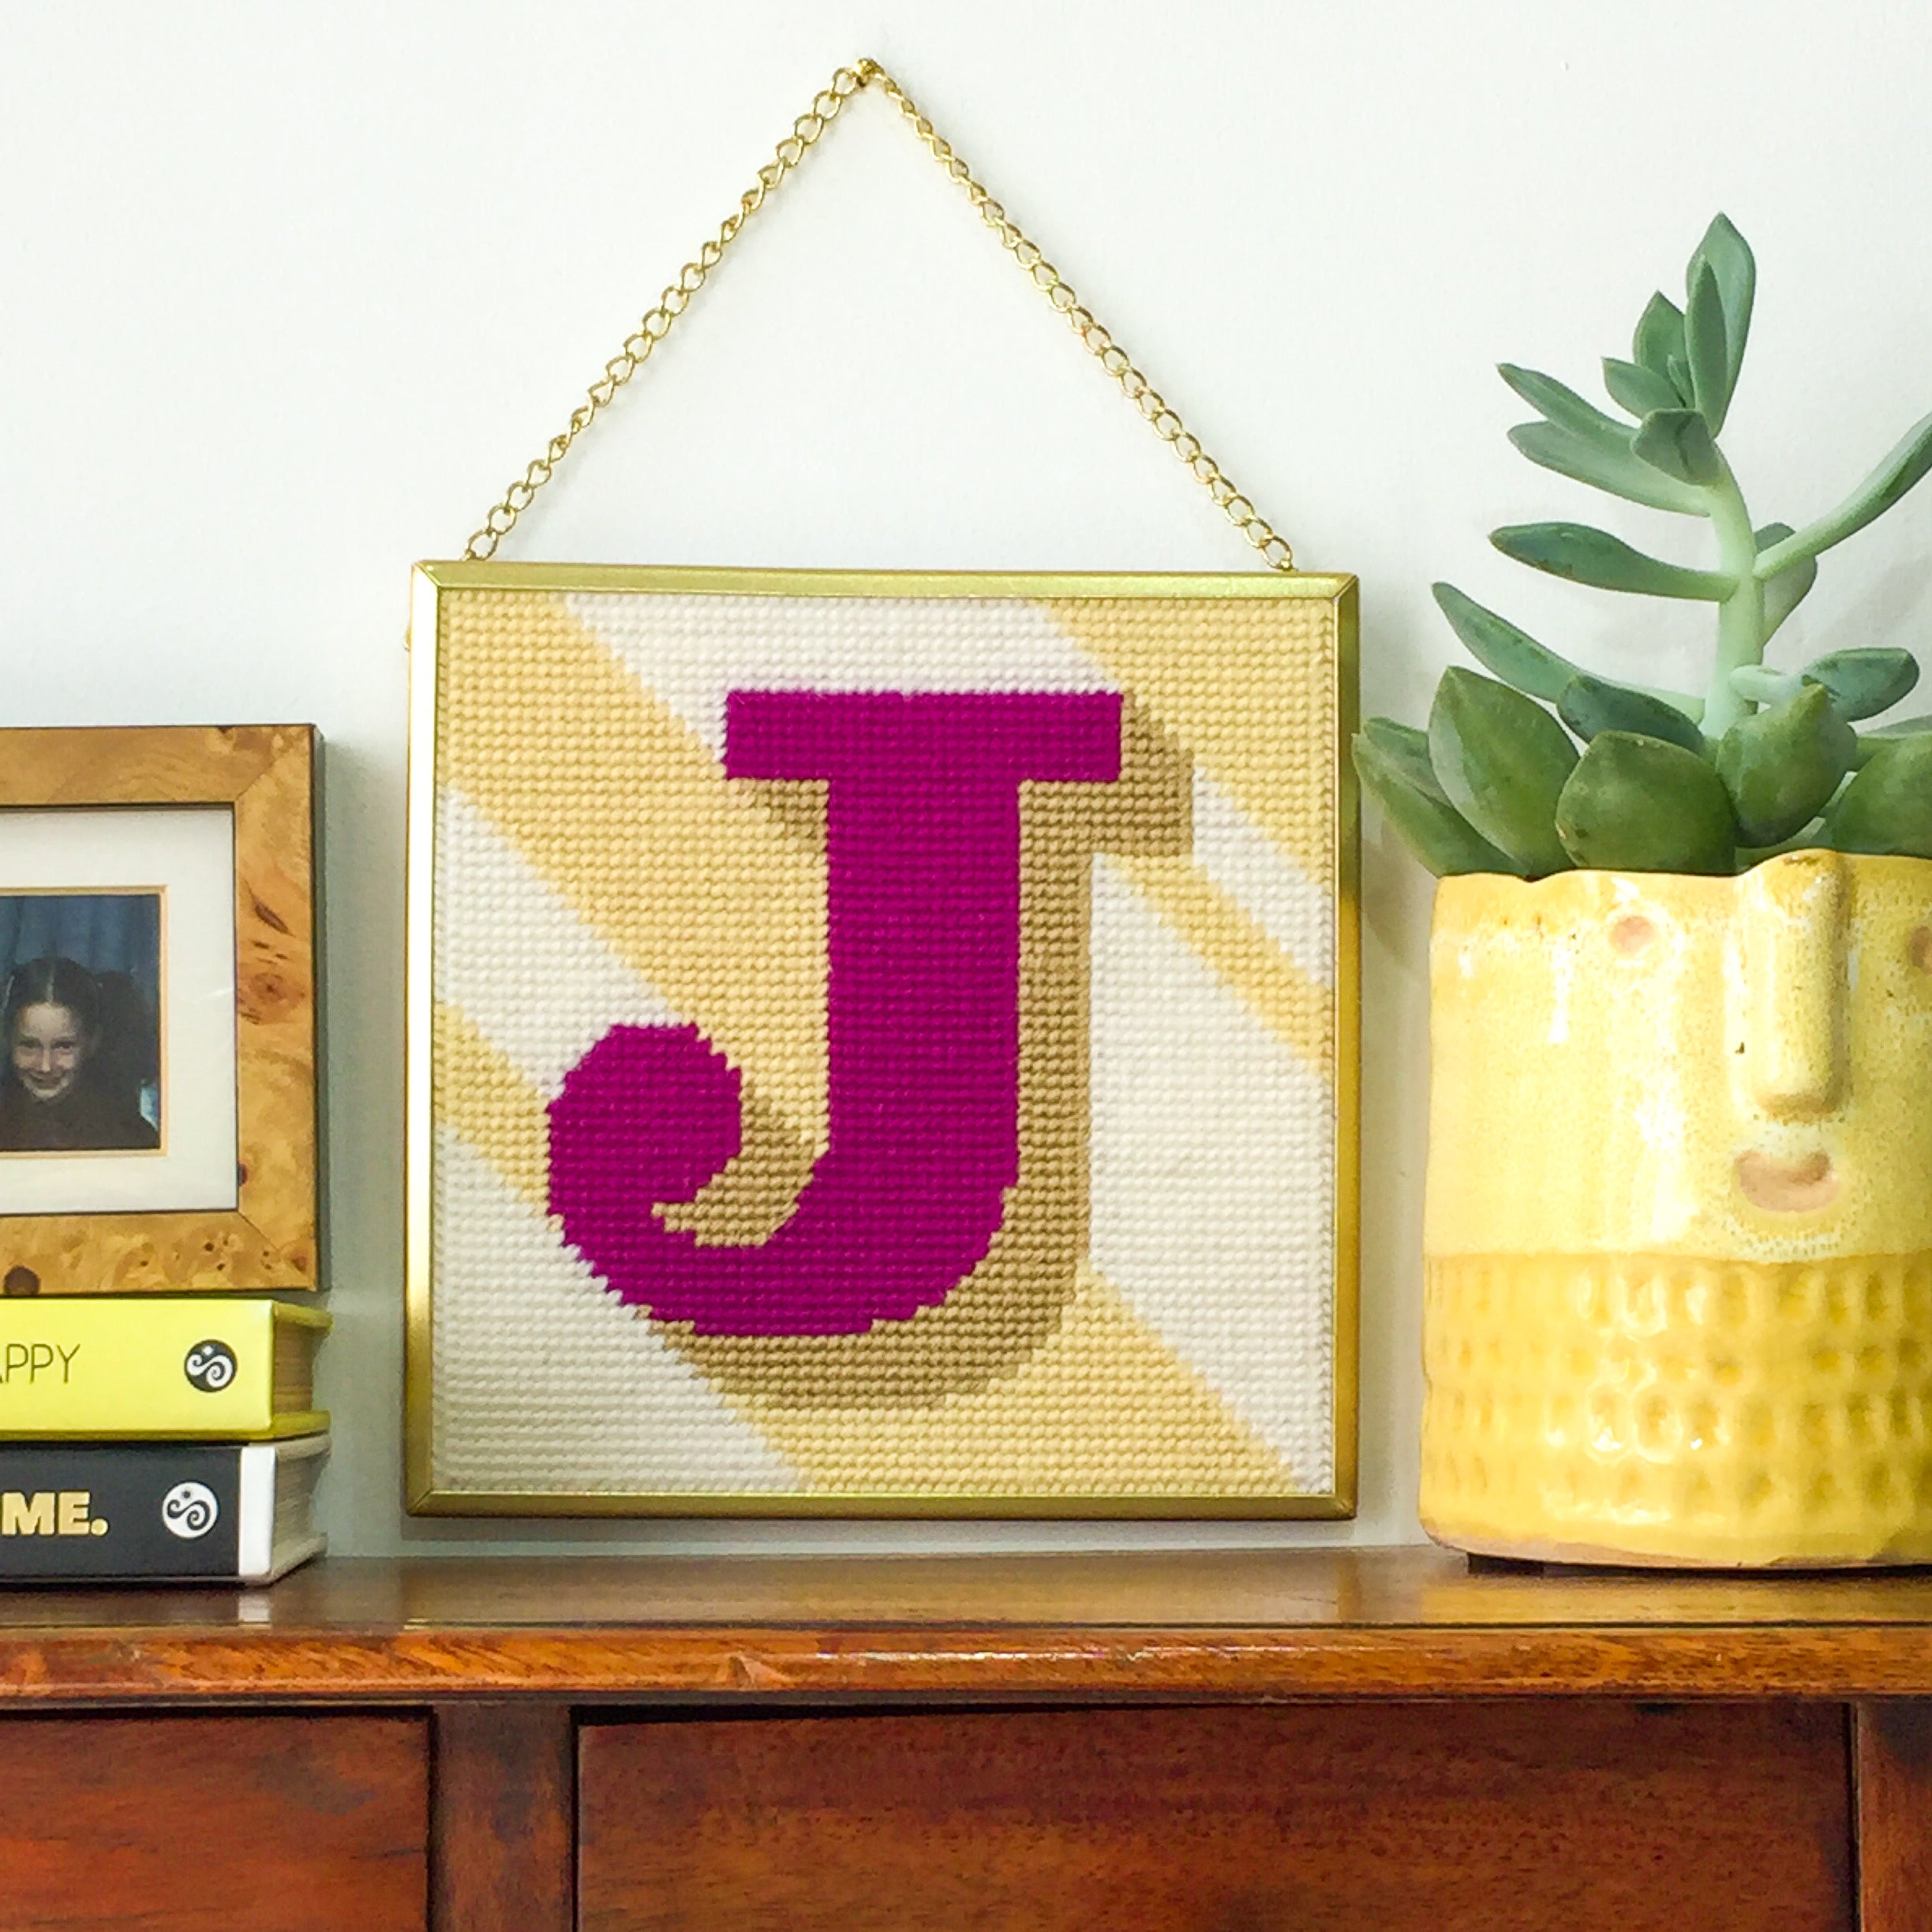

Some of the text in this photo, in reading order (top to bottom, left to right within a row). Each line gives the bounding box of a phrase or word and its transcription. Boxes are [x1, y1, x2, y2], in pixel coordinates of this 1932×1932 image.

[546, 688, 1123, 1337] J
[0, 1343, 80, 1383] PPY
[1, 1492, 109, 1536] ME.
